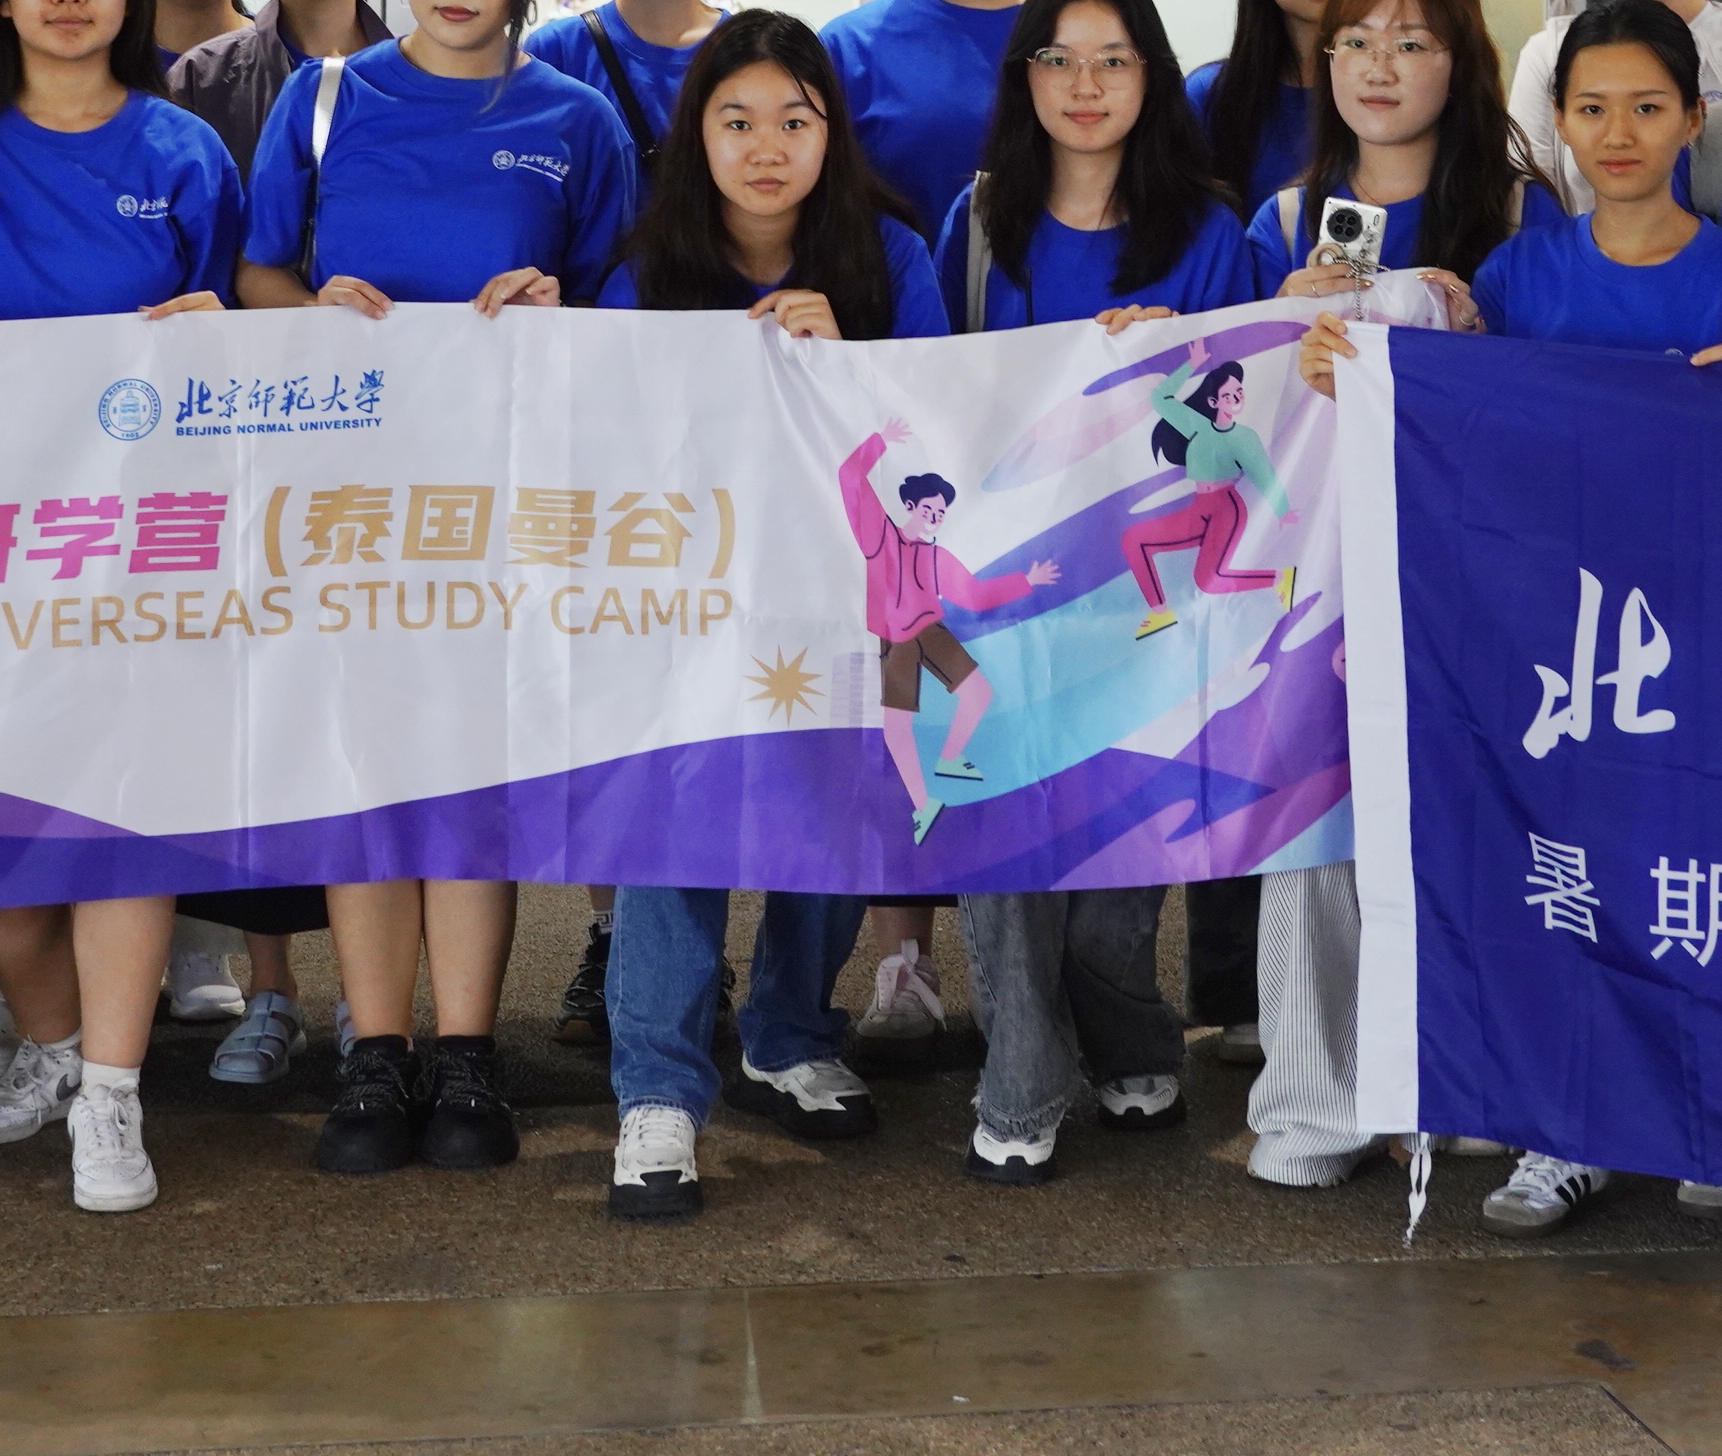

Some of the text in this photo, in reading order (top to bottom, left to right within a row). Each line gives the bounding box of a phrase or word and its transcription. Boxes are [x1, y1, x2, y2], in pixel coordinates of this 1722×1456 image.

[175, 417, 383, 437] BEIJING NORMAL UNIVERSITY
[317, 581, 530, 634] STUDY
[550, 585, 734, 637] CAMP
